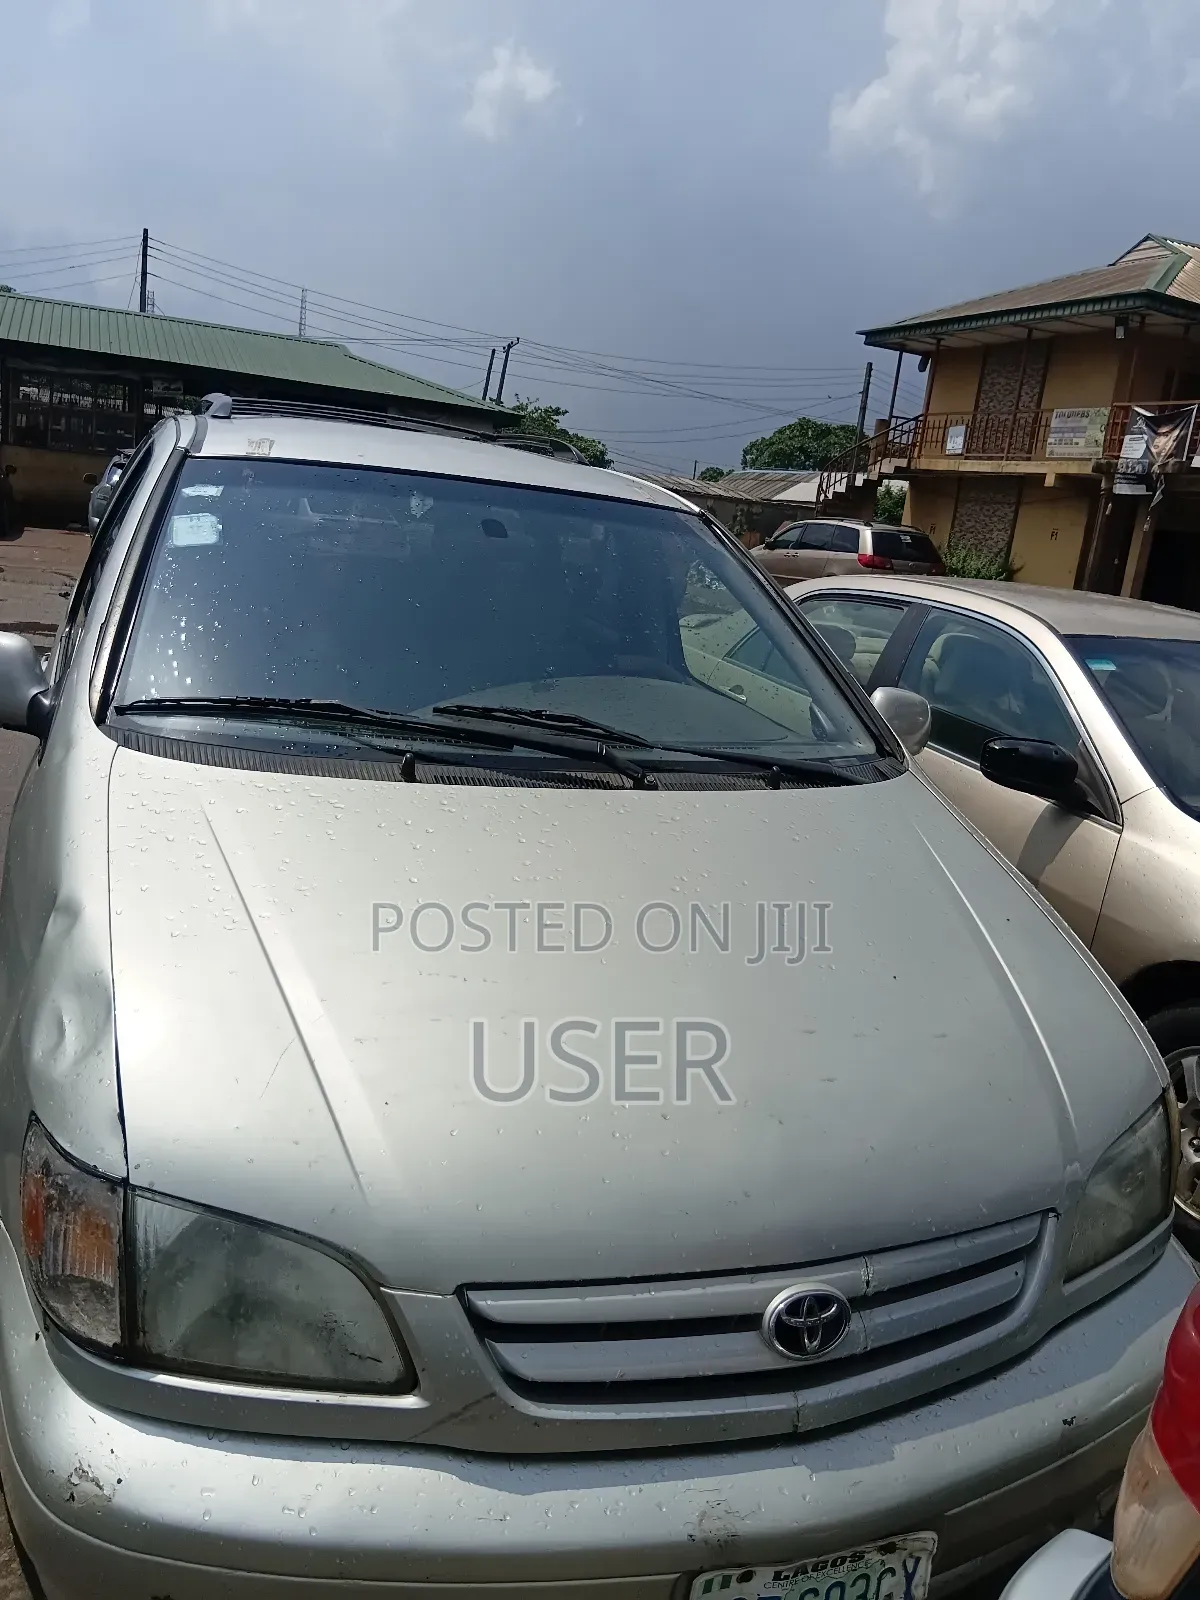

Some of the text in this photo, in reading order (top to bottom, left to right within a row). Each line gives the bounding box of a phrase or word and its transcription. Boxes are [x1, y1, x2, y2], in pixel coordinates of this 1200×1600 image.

[763, 1559, 873, 1589] CENTRE OF EXCELLENCE
[772, 1552, 866, 1580] LAGOS
